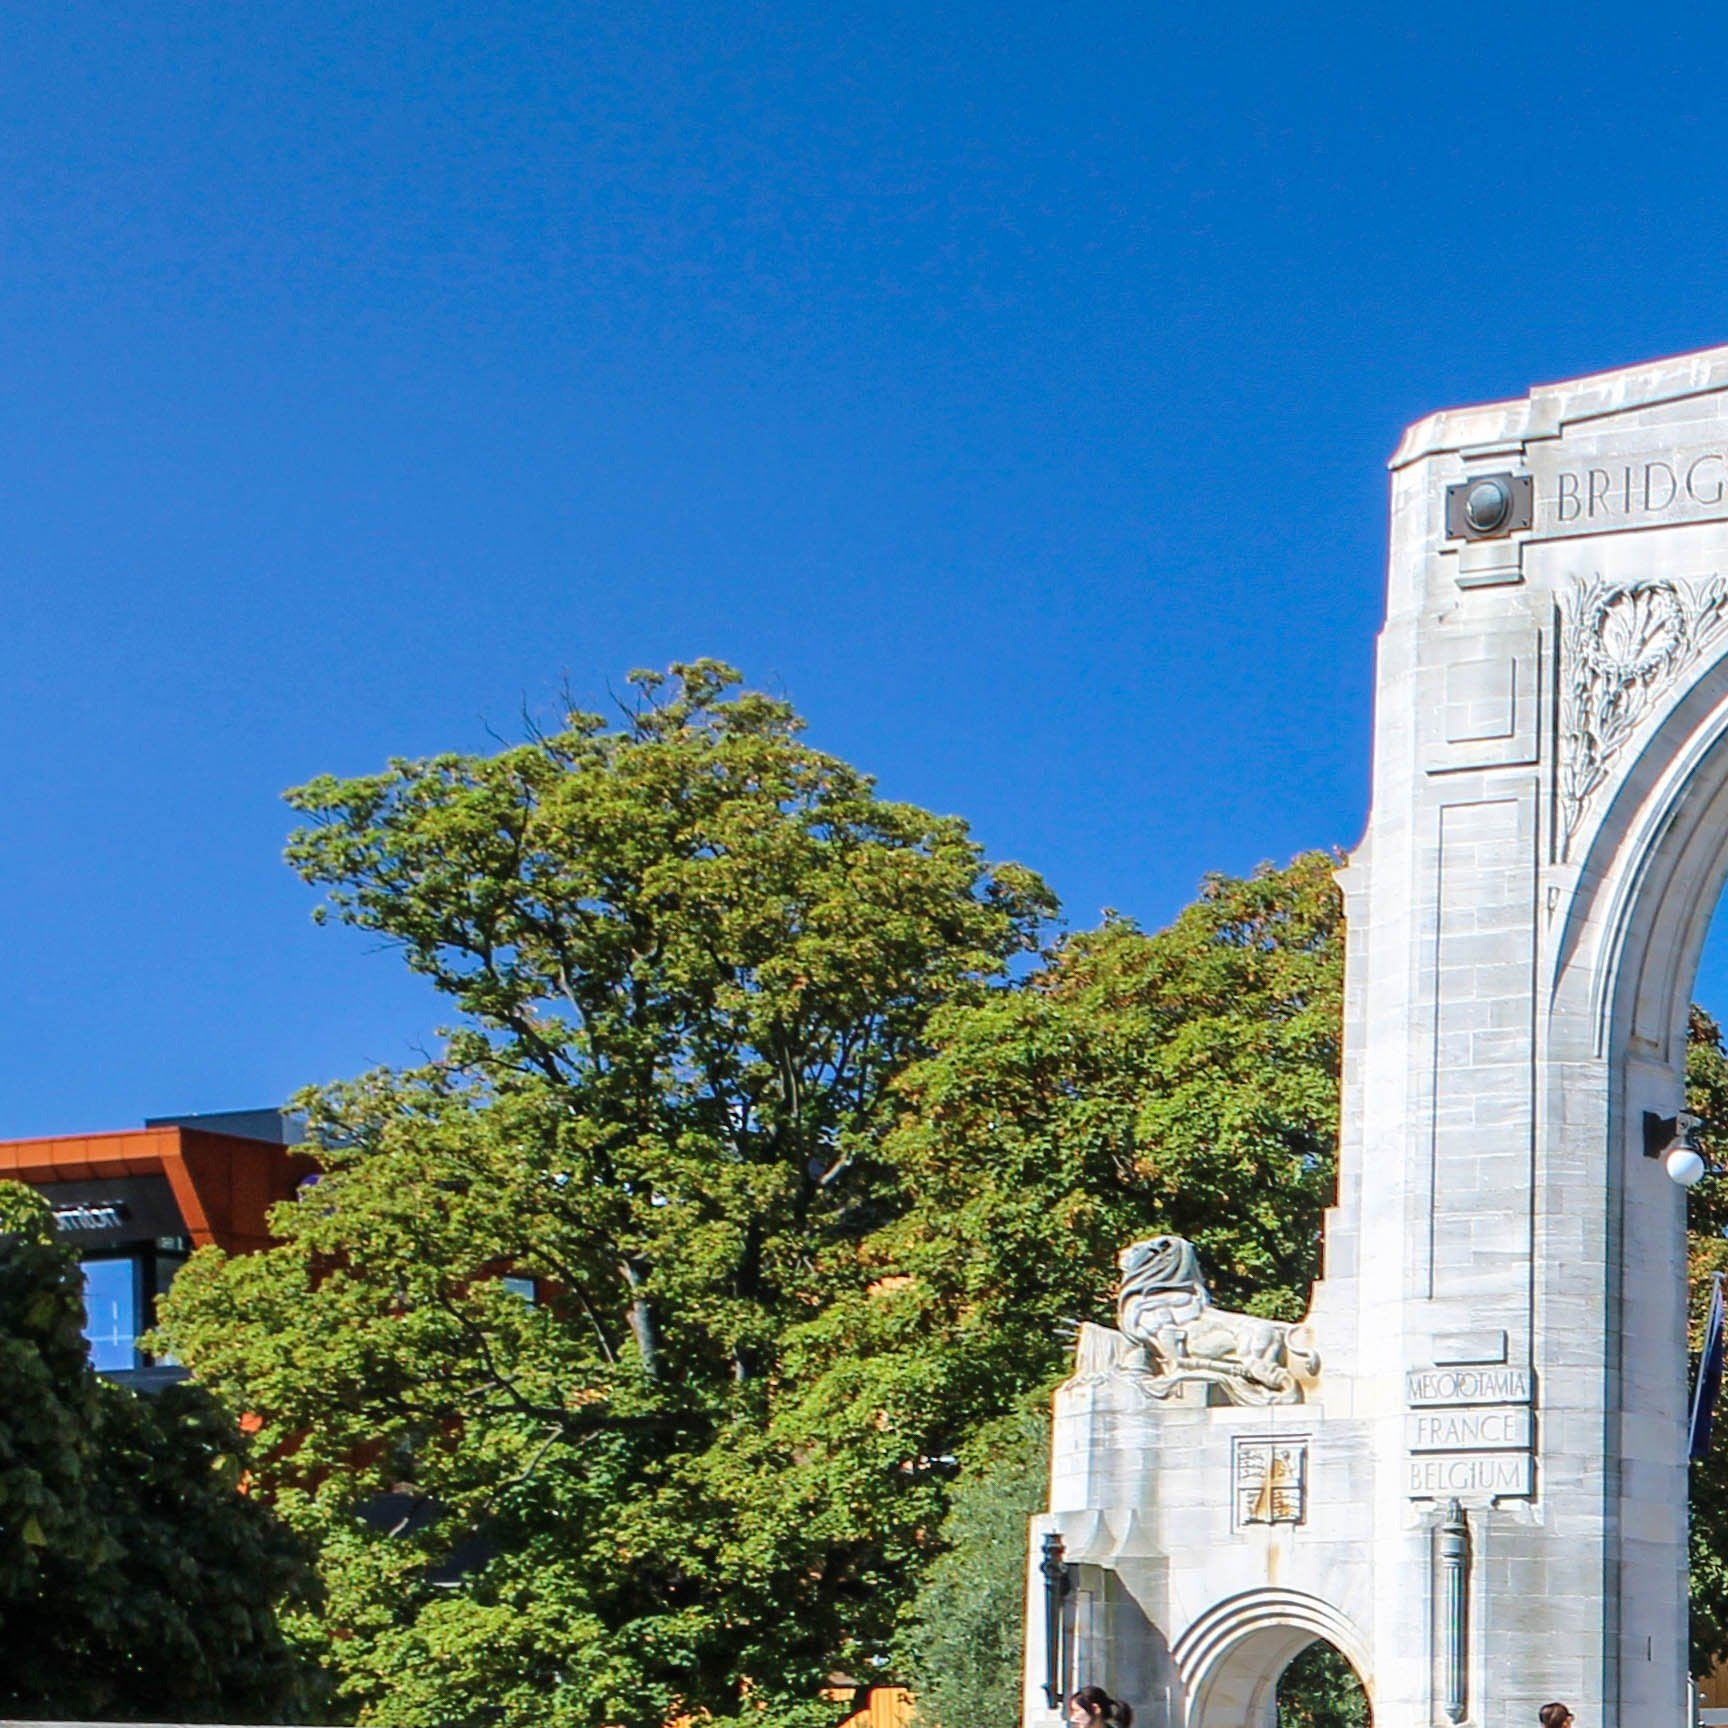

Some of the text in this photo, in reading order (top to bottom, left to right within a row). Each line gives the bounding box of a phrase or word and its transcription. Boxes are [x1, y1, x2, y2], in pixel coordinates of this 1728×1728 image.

[1407, 1370, 1526, 1400] MESOPOTAMIA
[1417, 1415, 1514, 1444] FRANCE
[1410, 1461, 1520, 1490] BELGIUM
